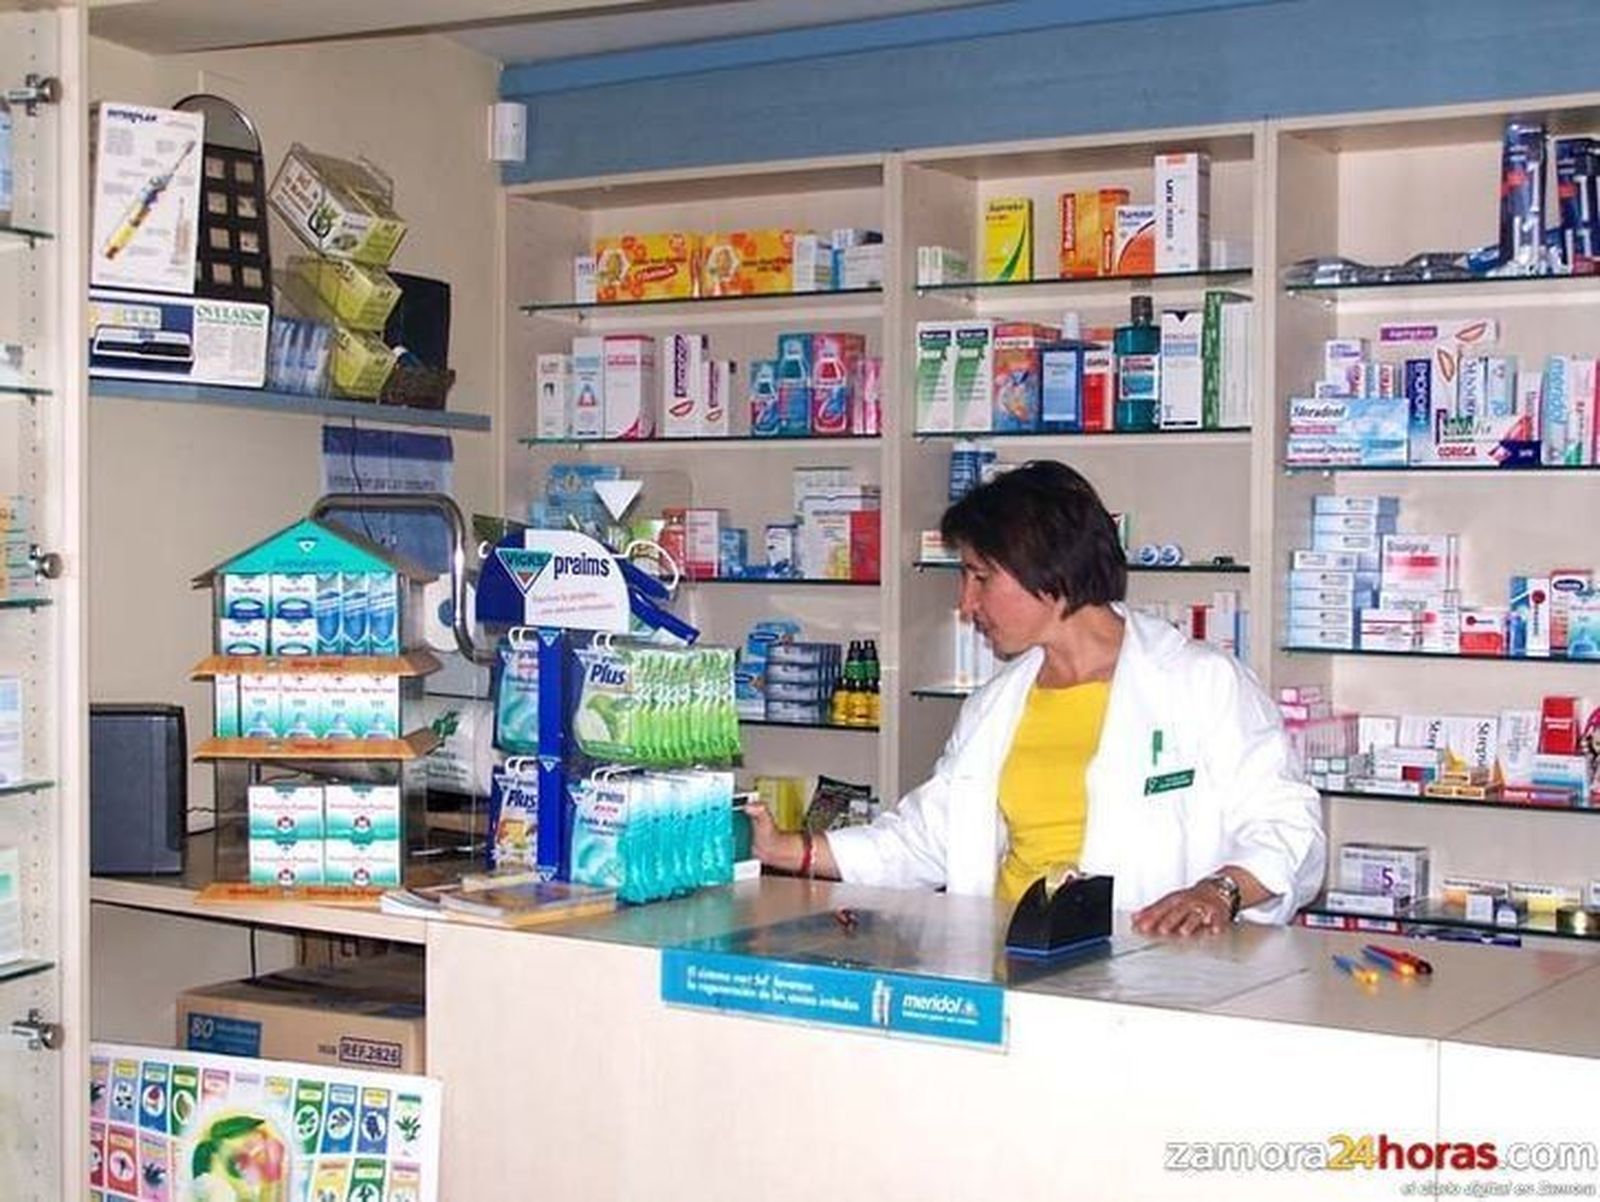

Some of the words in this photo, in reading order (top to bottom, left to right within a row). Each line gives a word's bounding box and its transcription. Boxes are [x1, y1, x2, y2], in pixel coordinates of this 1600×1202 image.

[553, 552, 611, 580] praims
[590, 664, 626, 686] Plus
[903, 993, 964, 1014] meridol
